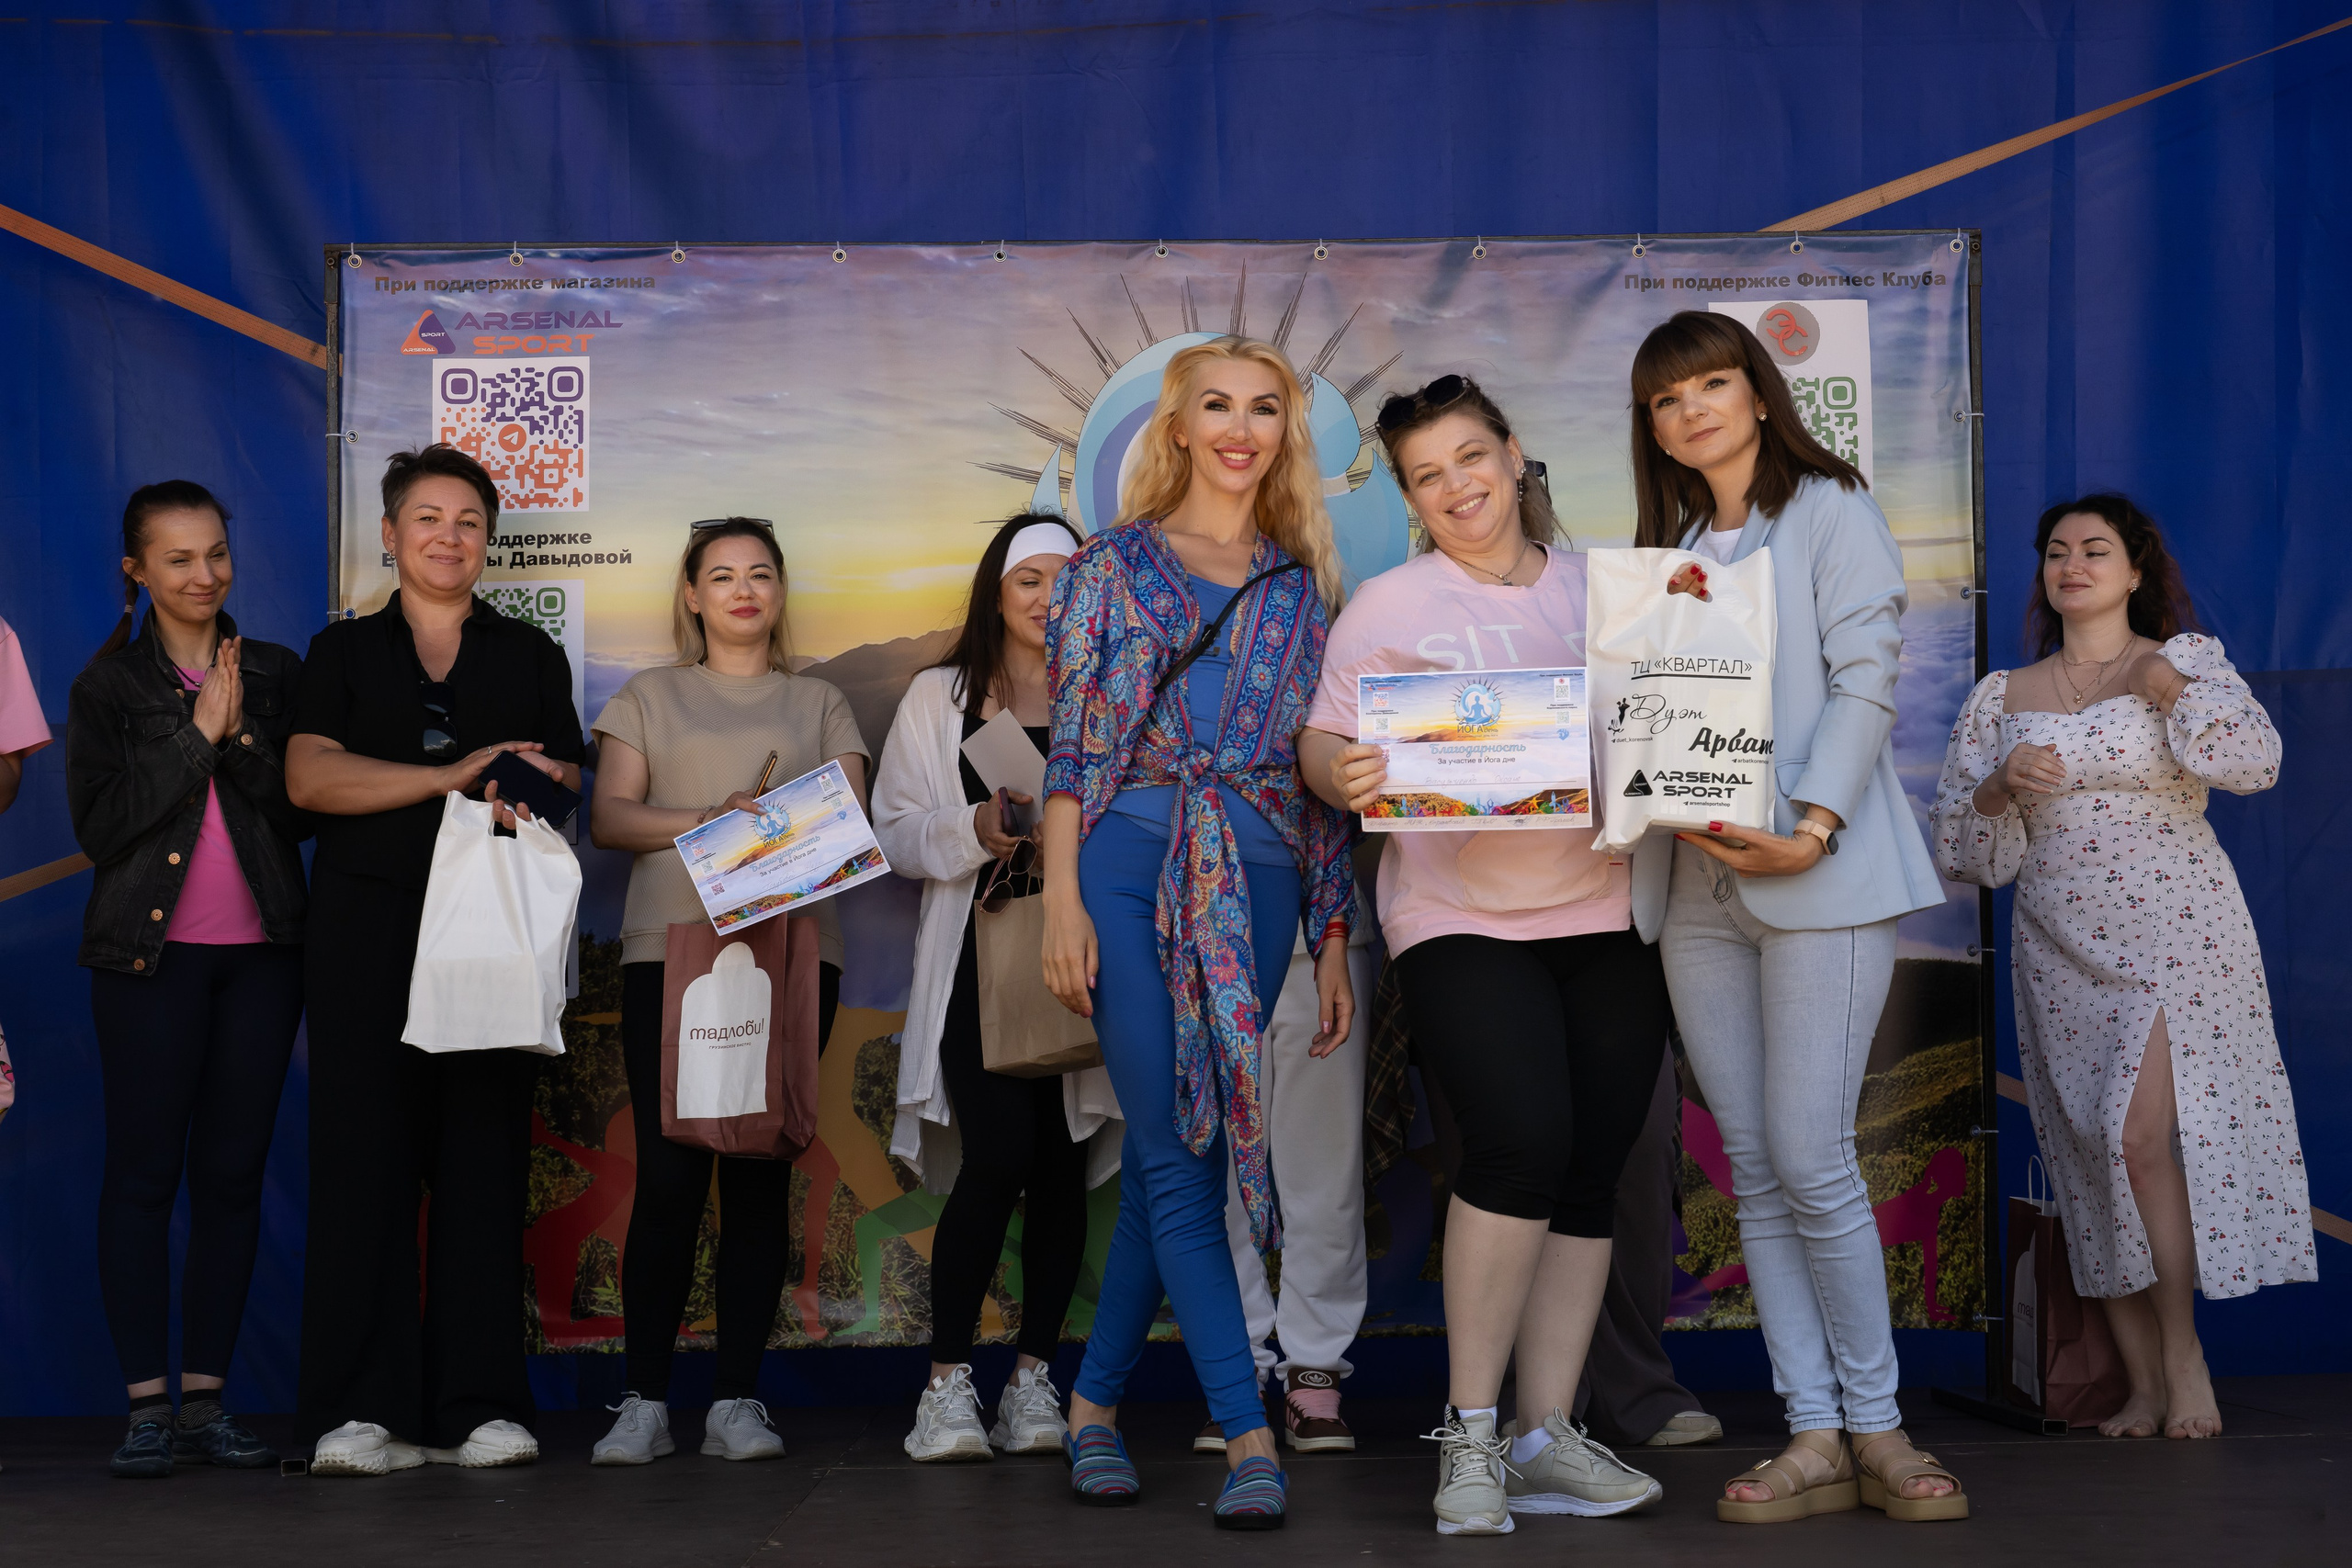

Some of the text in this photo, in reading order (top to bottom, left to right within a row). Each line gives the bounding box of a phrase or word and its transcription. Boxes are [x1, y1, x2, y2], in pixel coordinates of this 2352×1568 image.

[375, 276, 656, 295] При поддержке магазина
[1625, 270, 1946, 292] При поддержке Фитнес Клуба
[455, 310, 624, 331] ARSENAL
[473, 333, 595, 355] SPORT
[487, 532, 593, 548] оддержке
[510, 548, 632, 569] Давыдовой
[1631, 657, 1753, 675] ТЦ «КВАРТАЛ»
[1429, 742, 1527, 759] Благодарность
[1688, 727, 1774, 759] Арбат
[1449, 758, 1476, 766] участие
[1485, 755, 1500, 763] Йога
[1653, 770, 1753, 785] ARSENAL
[1663, 785, 1736, 799] SPORT
